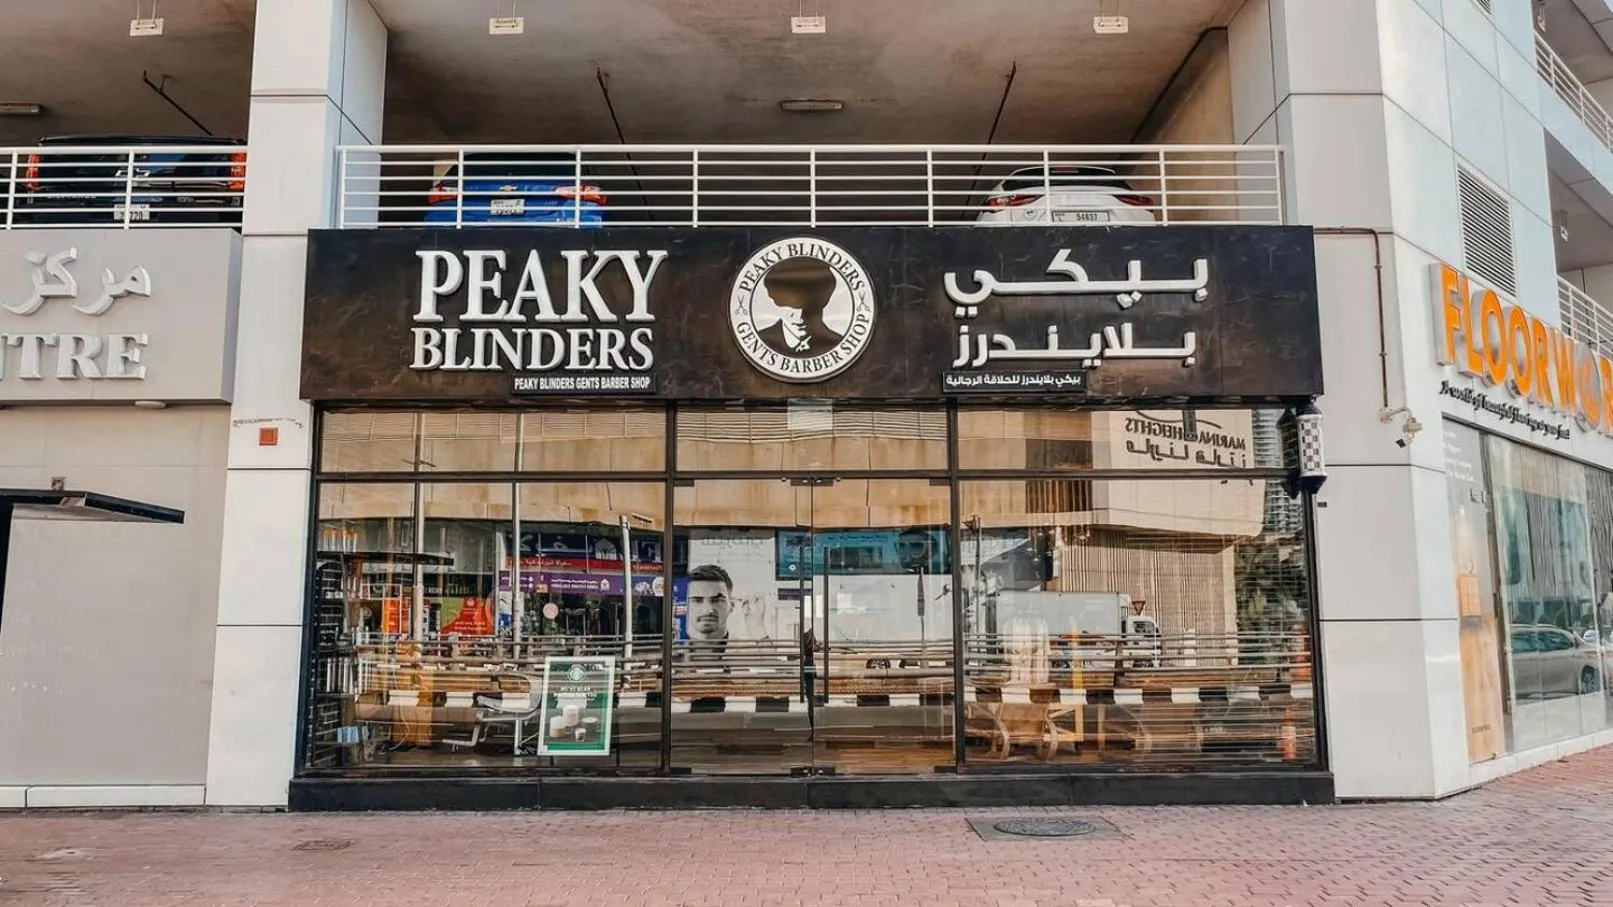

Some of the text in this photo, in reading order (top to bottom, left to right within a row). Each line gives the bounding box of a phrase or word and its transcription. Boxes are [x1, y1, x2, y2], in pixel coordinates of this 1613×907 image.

[0, 246, 152, 316] مركز
[413, 249, 669, 323] PEAKY
[740, 242, 865, 293] PEAKY BLINDERS
[943, 248, 1209, 319] بيكي
[0, 333, 149, 380] TRE
[409, 327, 655, 371] BLINDERS
[736, 313, 870, 373] GENTS BARBER SHOP
[952, 321, 1197, 369] بلايندرز
[514, 377, 650, 390] PEAKY BLINDERS GENTS BARBER SHOP
[946, 374, 1081, 387] بيكي بلايندرز للحلاقة الرجالية
